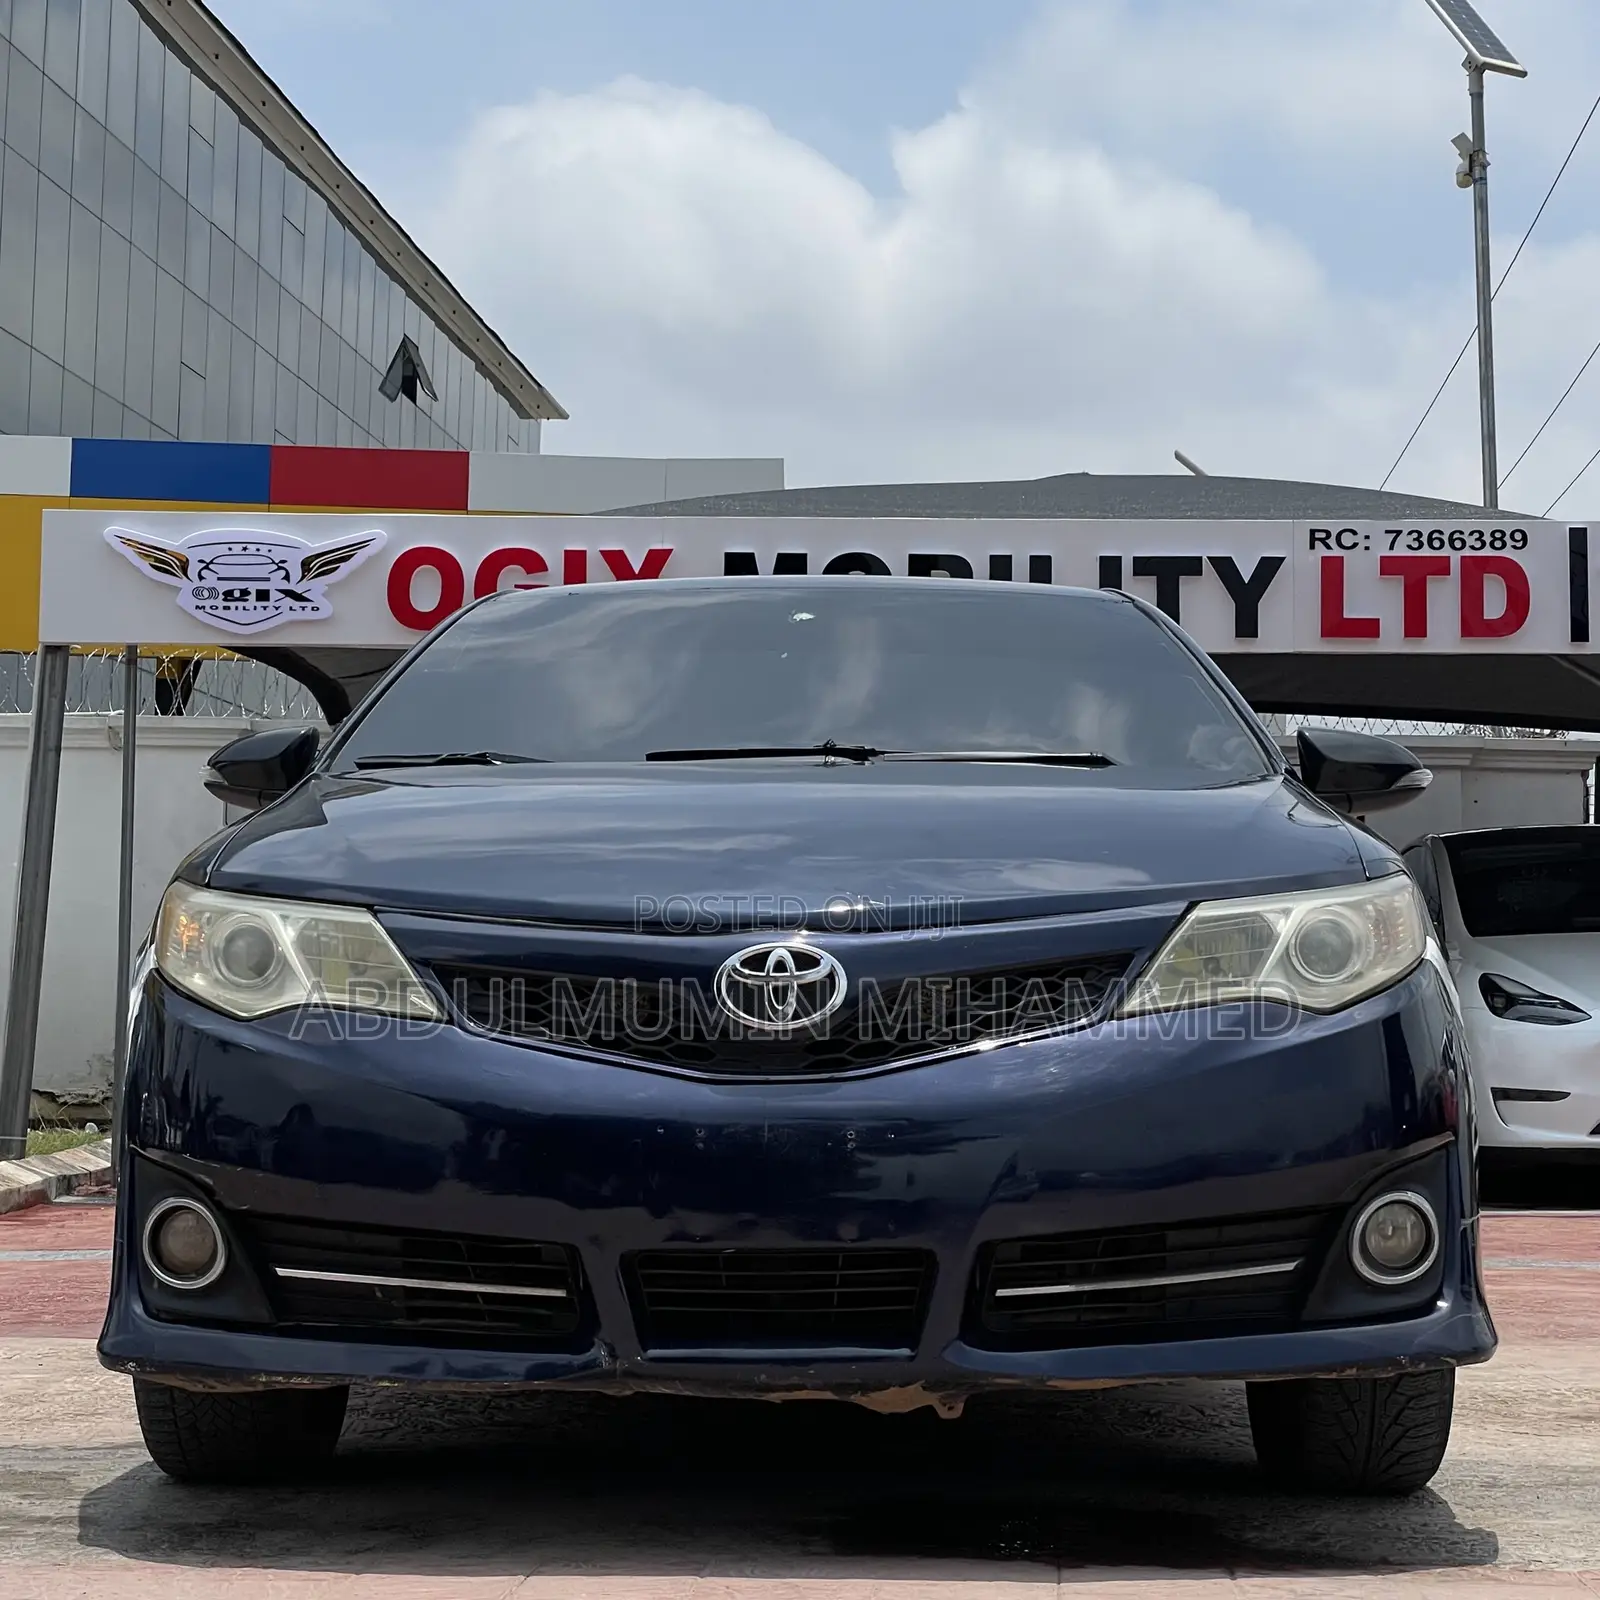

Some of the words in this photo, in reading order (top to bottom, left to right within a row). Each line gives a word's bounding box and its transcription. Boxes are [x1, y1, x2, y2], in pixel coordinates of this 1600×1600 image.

[1308, 528, 1371, 551] RC:
[1384, 528, 1529, 551] 7366389
[194, 604, 282, 612] MOBILITY
[1320, 555, 1531, 639] LTD
